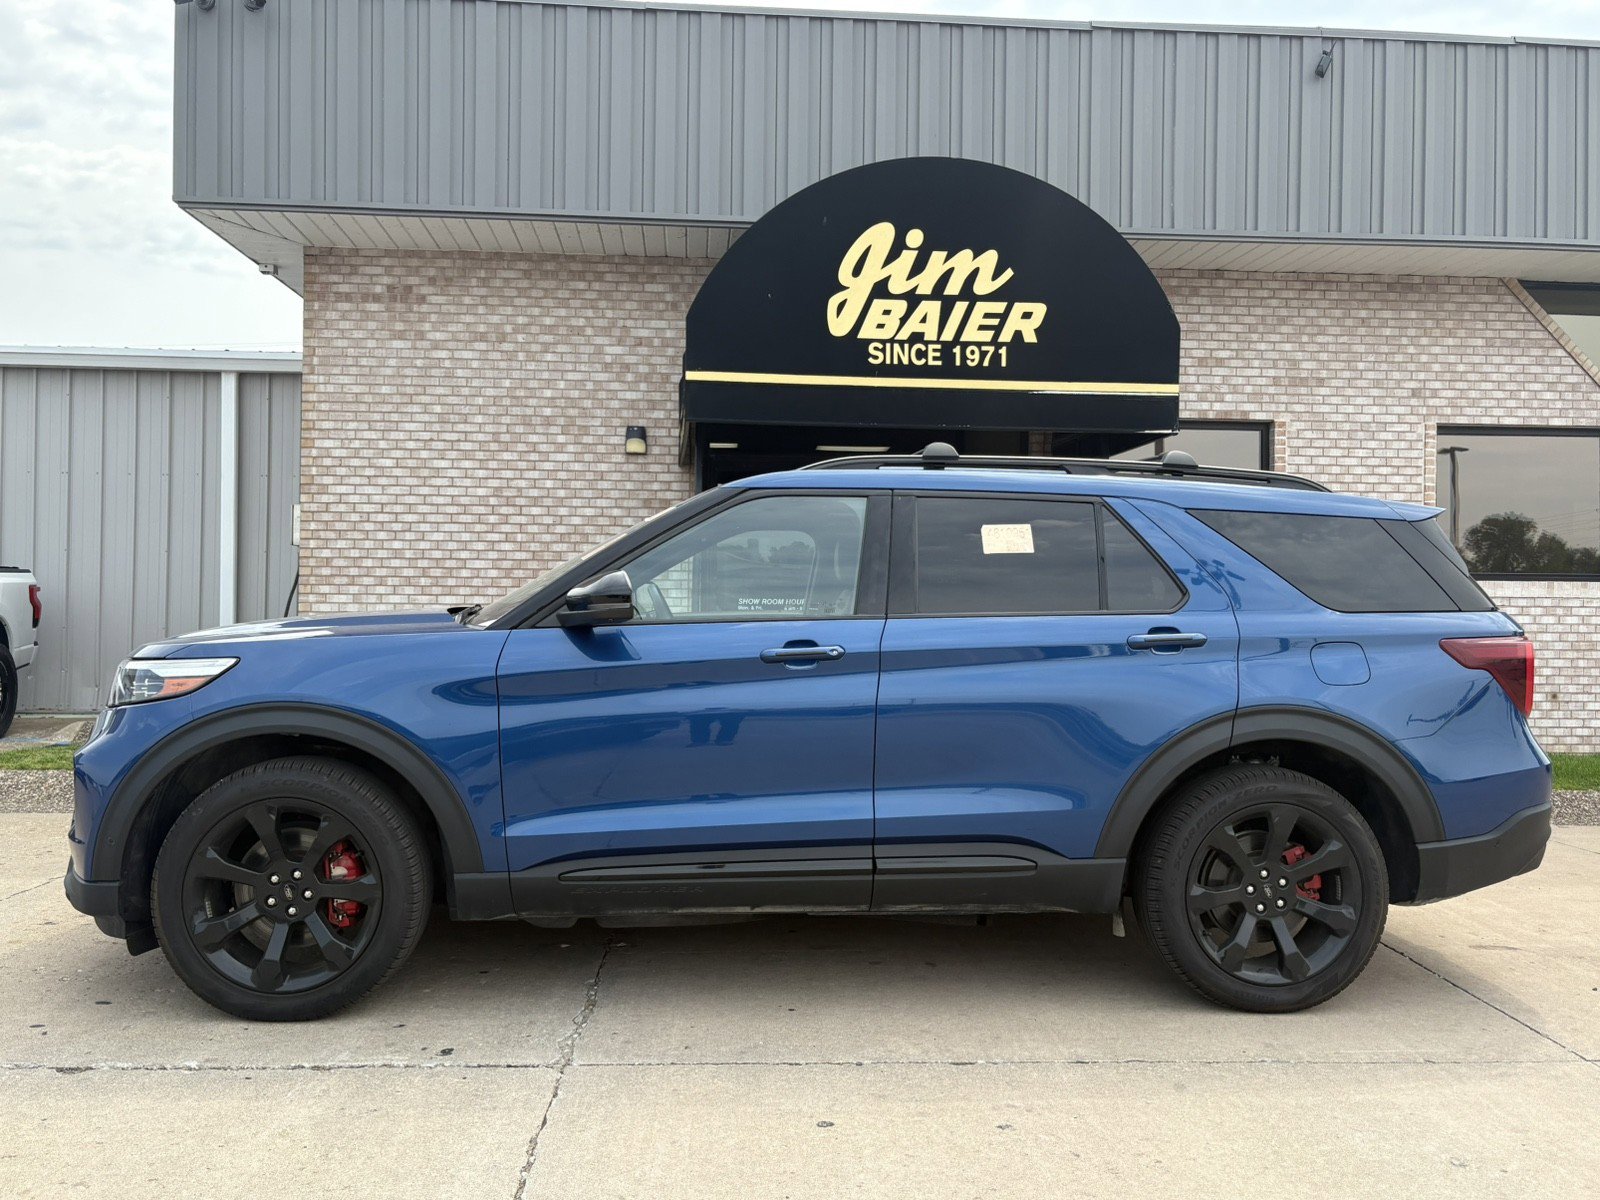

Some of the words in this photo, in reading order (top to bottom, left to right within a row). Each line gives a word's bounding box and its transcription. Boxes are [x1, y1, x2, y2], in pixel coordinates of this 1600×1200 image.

[827, 222, 1014, 337] Jim
[857, 299, 1048, 343] BAIER
[868, 342, 943, 366] SINCE
[952, 345, 1007, 368] 1971
